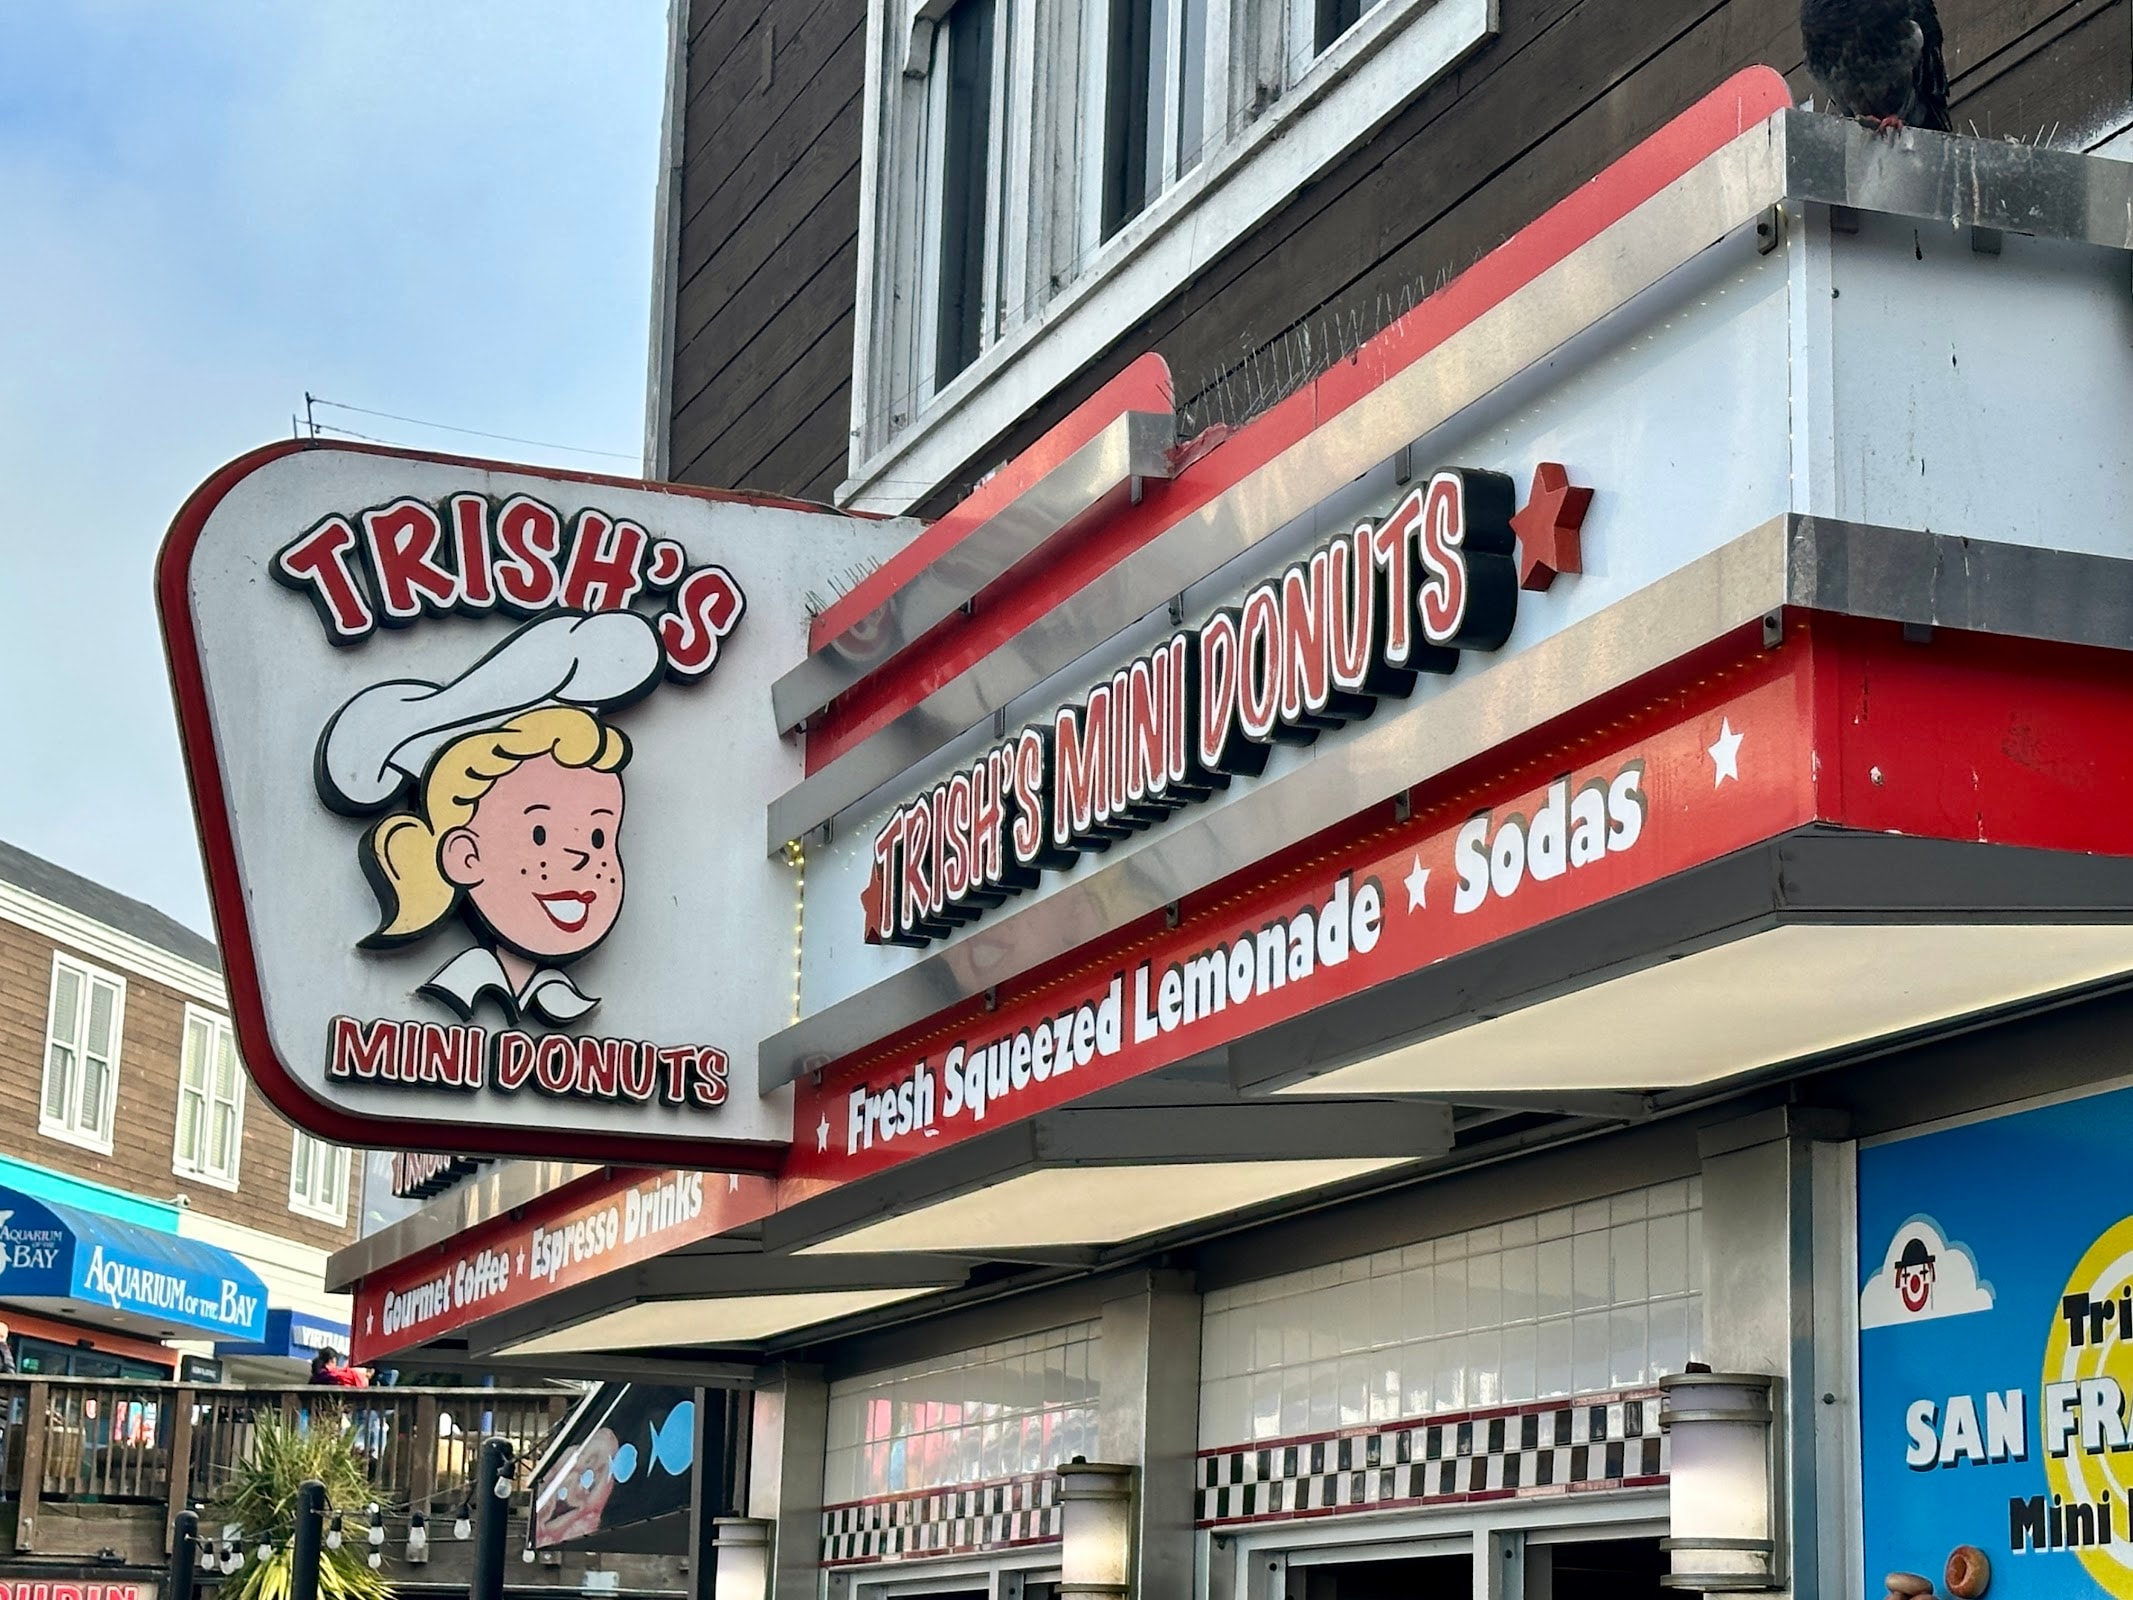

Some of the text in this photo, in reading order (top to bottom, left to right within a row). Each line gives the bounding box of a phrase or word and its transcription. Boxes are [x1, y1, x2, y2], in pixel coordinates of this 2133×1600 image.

[274, 492, 746, 680] TRISH'S
[874, 470, 1467, 940] TRISH'S MINI DONUTS
[847, 767, 1646, 1156] Fresh Squeezed Lemonade Sodas
[330, 1017, 730, 1105] MINI DONUTS
[0, 1225, 62, 1244] AQUARIUM
[13, 1245, 59, 1269] BAY
[383, 1170, 703, 1336] Gourmet Coffee Espresso Drinks
[84, 1245, 258, 1327] AQUARIUM OF THE BAY
[1906, 1376, 2133, 1468] SAN FR
[2010, 1489, 2112, 1552] Mini
